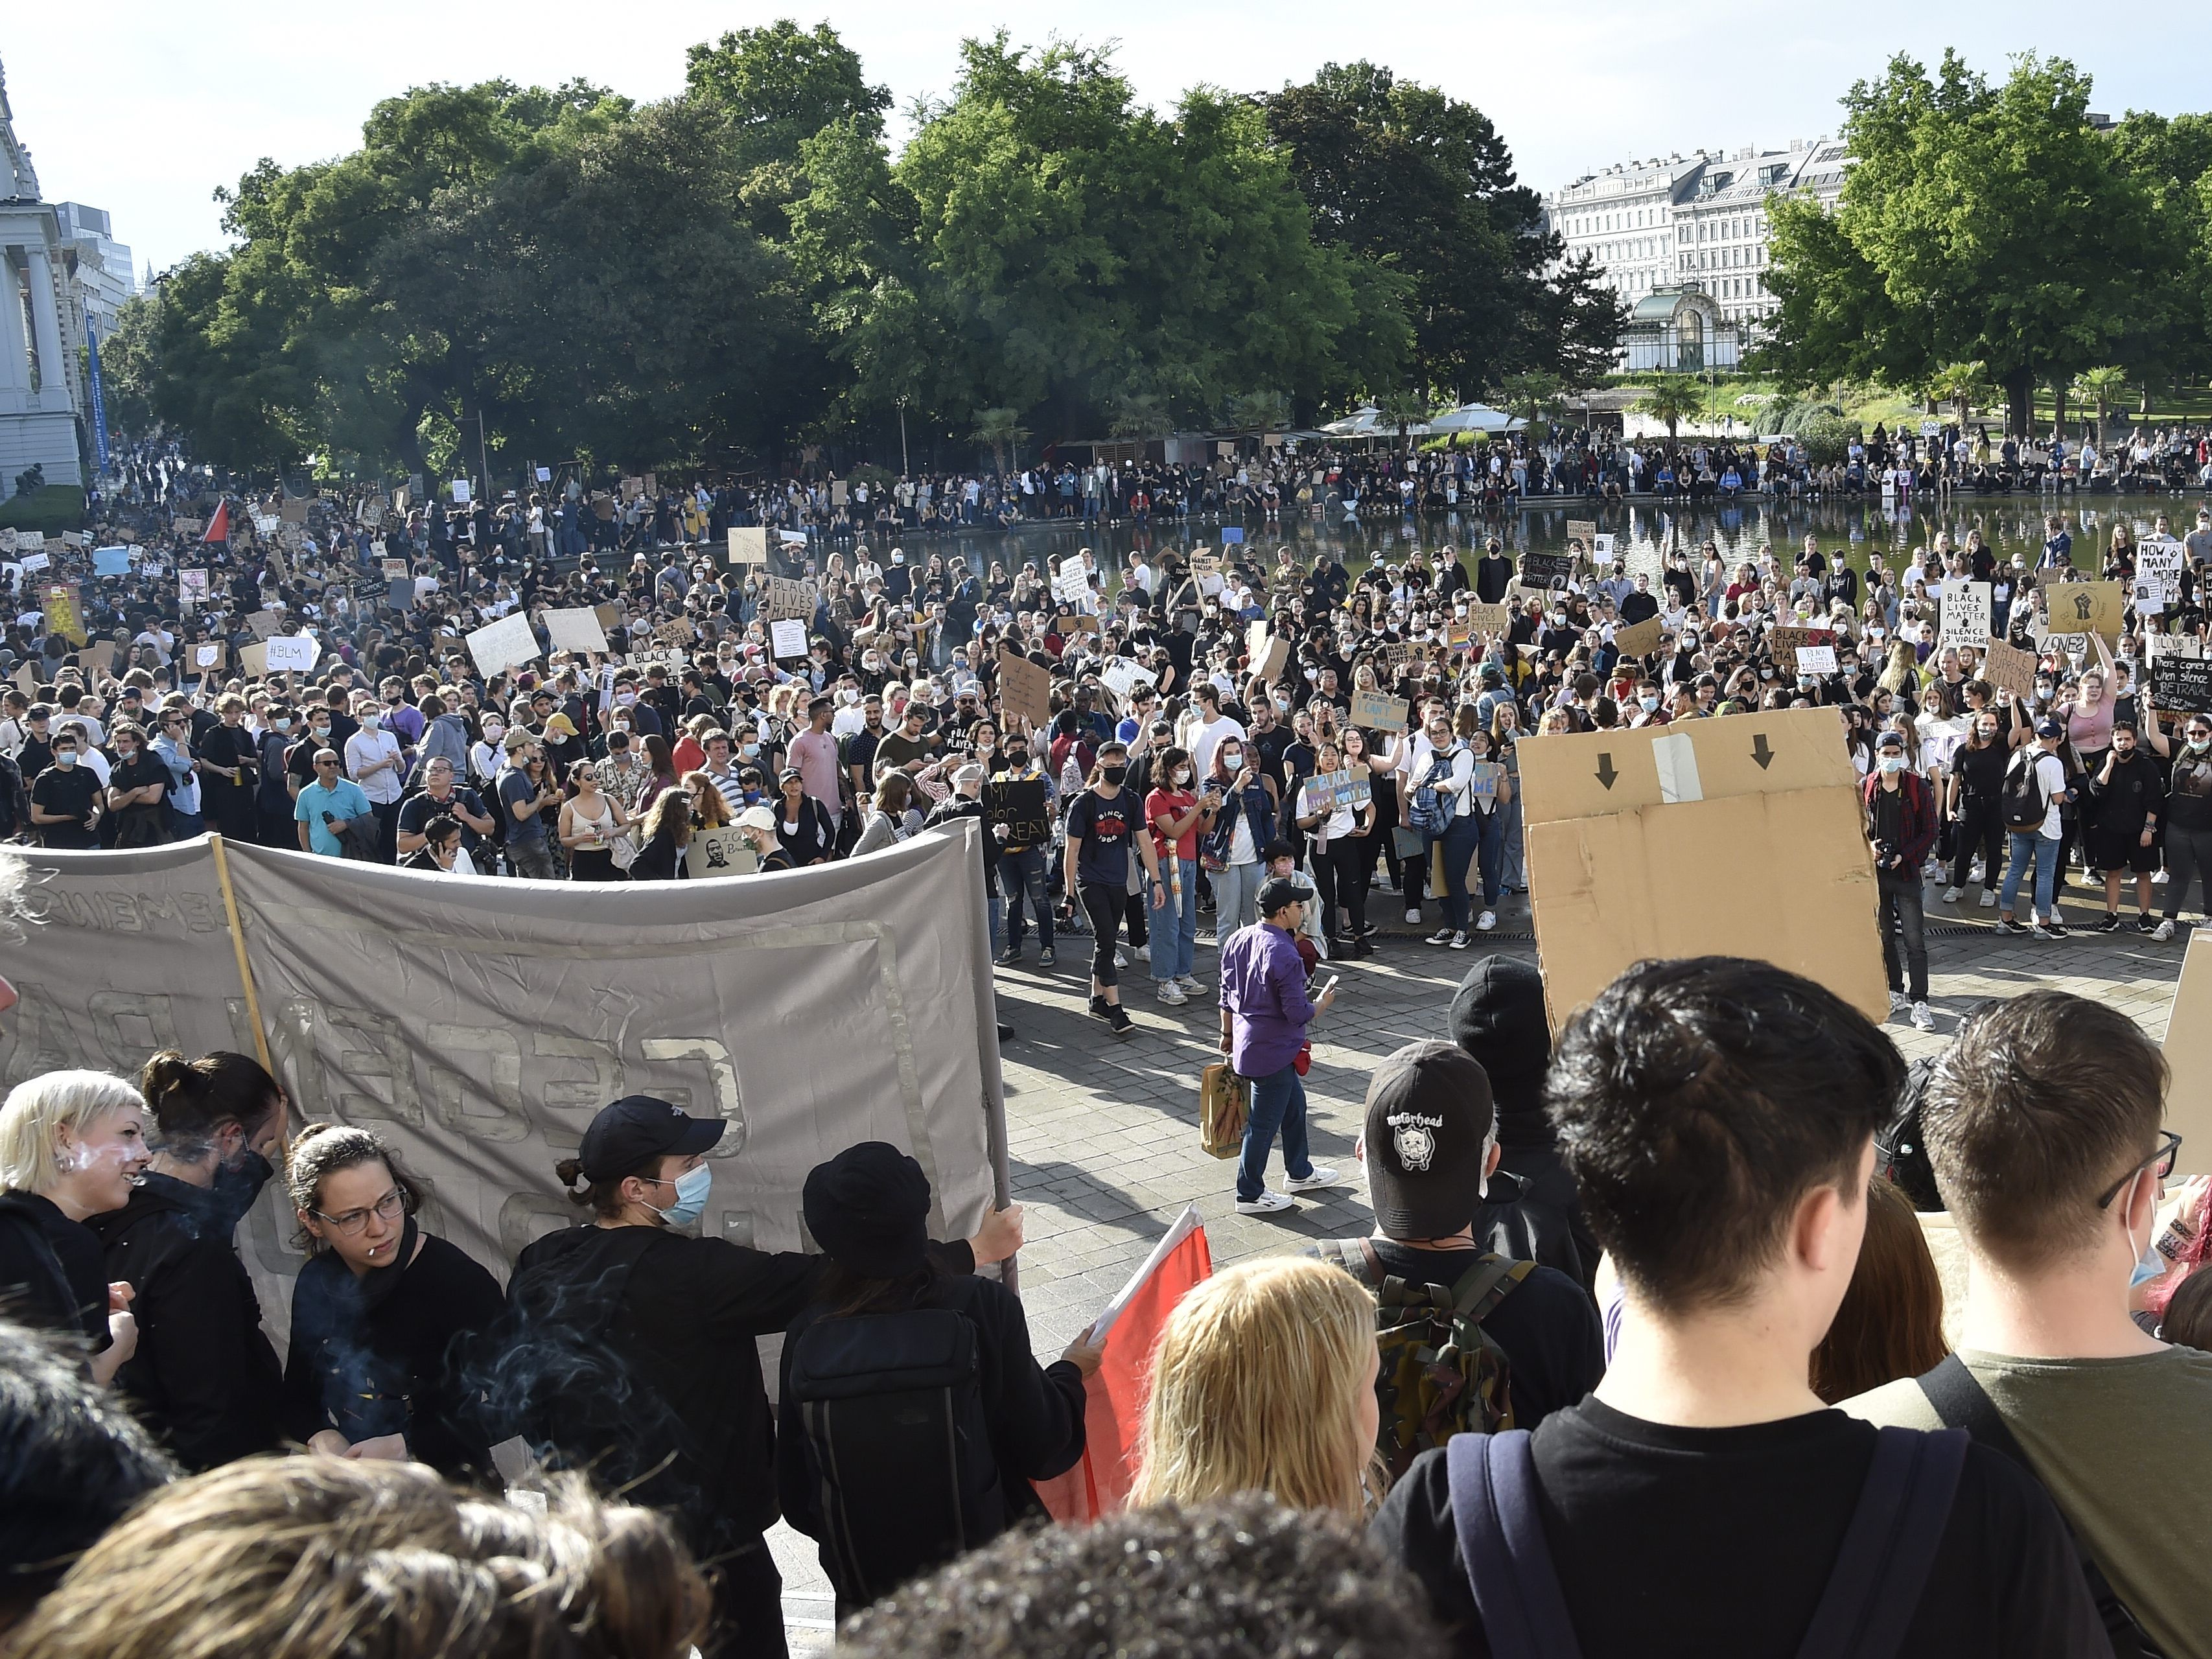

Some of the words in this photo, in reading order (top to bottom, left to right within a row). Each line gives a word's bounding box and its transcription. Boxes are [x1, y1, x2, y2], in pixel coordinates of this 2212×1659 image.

[2141, 544, 2165, 556] HOW
[2142, 557, 2173, 568] MANY
[1522, 573, 1549, 585] MATTER
[2152, 569, 2180, 581] MORE
[353, 578, 373, 587] LISTEN
[360, 582, 384, 594] SUPPORT
[773, 578, 813, 596] BLACK
[774, 592, 813, 609] LIVES
[1947, 593, 1982, 603] BLACK
[771, 606, 811, 619] MATTER
[1472, 605, 1496, 614] BLACK
[1946, 611, 1986, 621] MATTER
[658, 624, 676, 636] BLACK
[1472, 622, 1506, 631] MATTER
[666, 627, 685, 639] LIVES
[1775, 630, 1808, 641] BLACK
[1775, 640, 1806, 649] LIVES
[2189, 636, 2198, 647] IS
[270, 645, 302, 659] #BLM
[633, 649, 672, 664] BLACK
[1773, 649, 1797, 662] MAT
[1806, 649, 1826, 658] BLACK
[1991, 640, 2030, 669] WHITE
[2165, 649, 2183, 658] NOT
[1390, 655, 1417, 664] MATTER
[2154, 656, 2176, 668] There
[2179, 661, 2205, 670] comes
[2180, 669, 2209, 684] silence
[2159, 682, 2212, 697] BETRAYAL
[1391, 698, 1408, 708] FLOYD
[990, 783, 1011, 802] MY
[1098, 810, 1124, 820] SINCE
